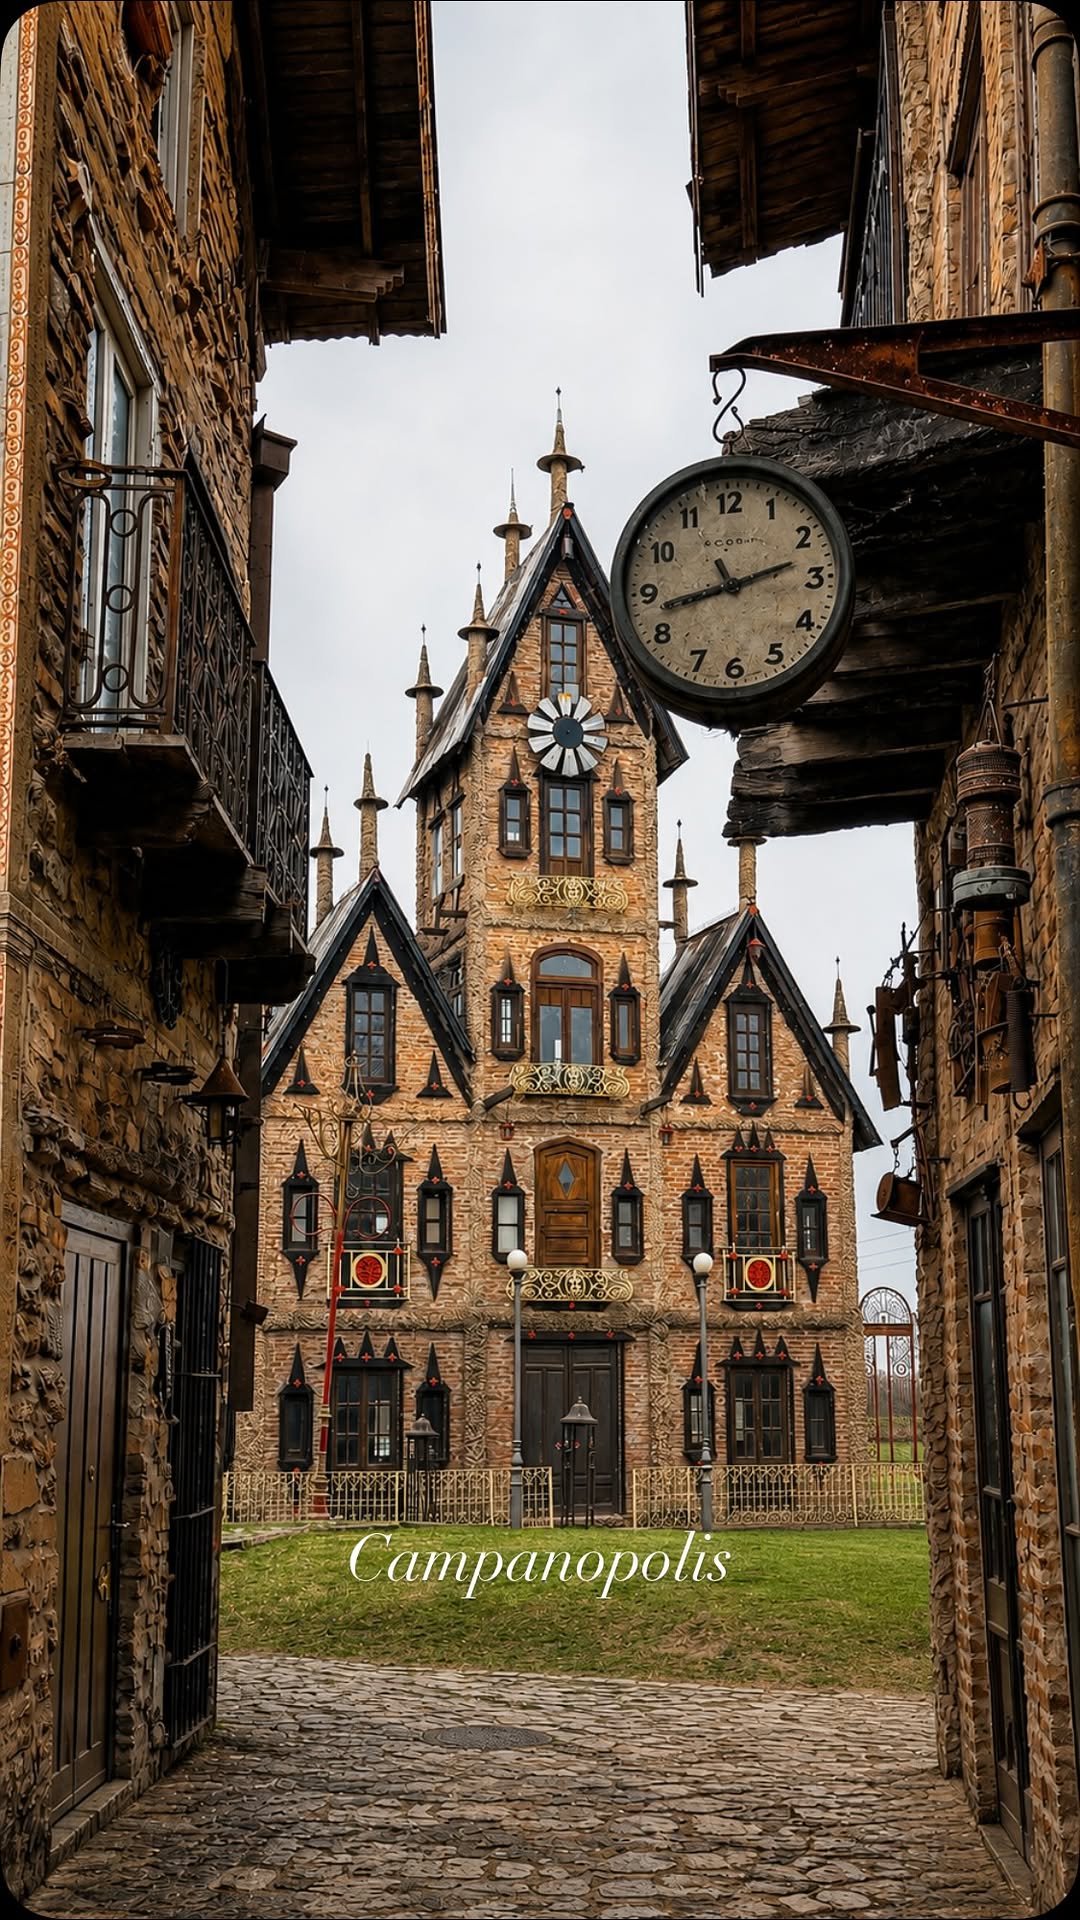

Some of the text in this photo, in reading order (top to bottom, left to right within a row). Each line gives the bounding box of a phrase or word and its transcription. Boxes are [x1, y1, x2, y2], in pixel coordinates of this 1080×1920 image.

[716, 491, 743, 515] 12
[766, 498, 776, 520] 1
[680, 507, 698, 529] 11
[795, 526, 811, 549] 2
[651, 541, 675, 564] 10
[805, 566, 825, 590] 3
[640, 583, 658, 604] 9
[795, 609, 815, 632] 4
[654, 623, 671, 644] 8
[690, 649, 708, 672] 7
[764, 643, 784, 665] 5
[725, 657, 745, 679] 6
